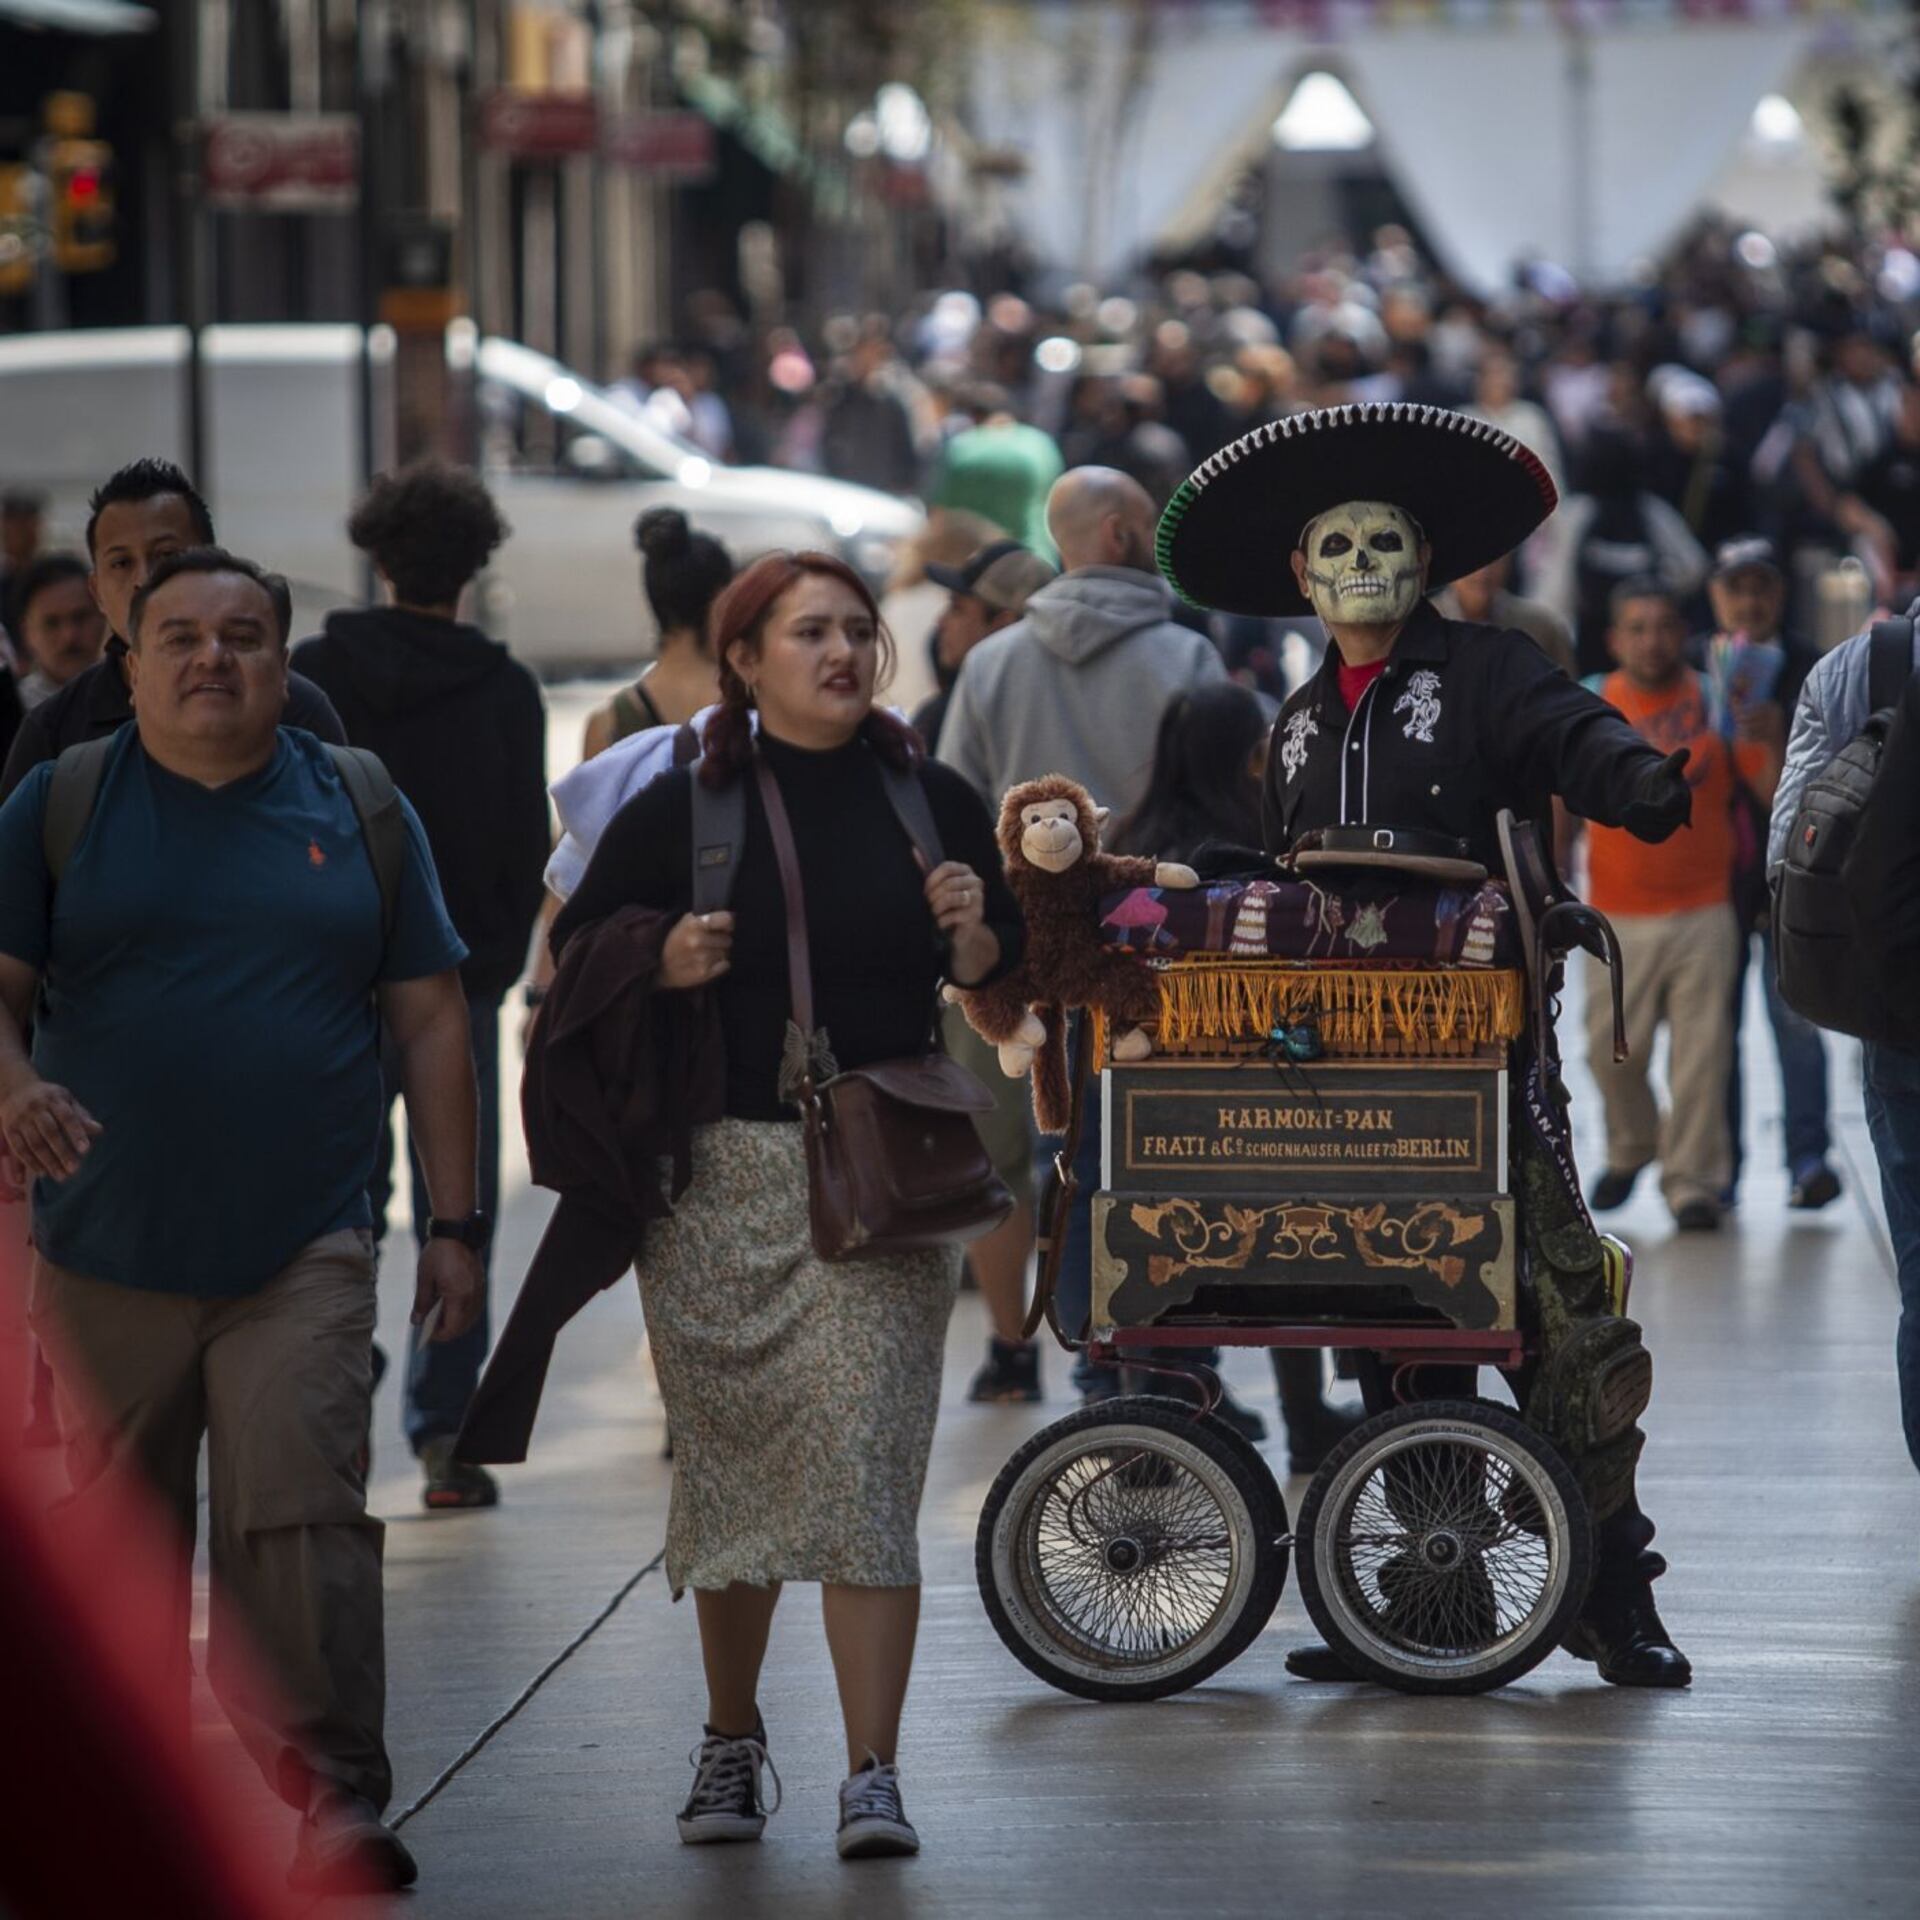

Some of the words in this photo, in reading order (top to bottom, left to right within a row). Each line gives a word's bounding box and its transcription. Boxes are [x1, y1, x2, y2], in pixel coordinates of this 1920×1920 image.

[1142, 1135, 1206, 1157] FRATI
[1246, 1142, 1342, 1158] SCHOENHAUSER
[1344, 1142, 1380, 1158] ALLEE
[1396, 1137, 1471, 1159] BERLIN
